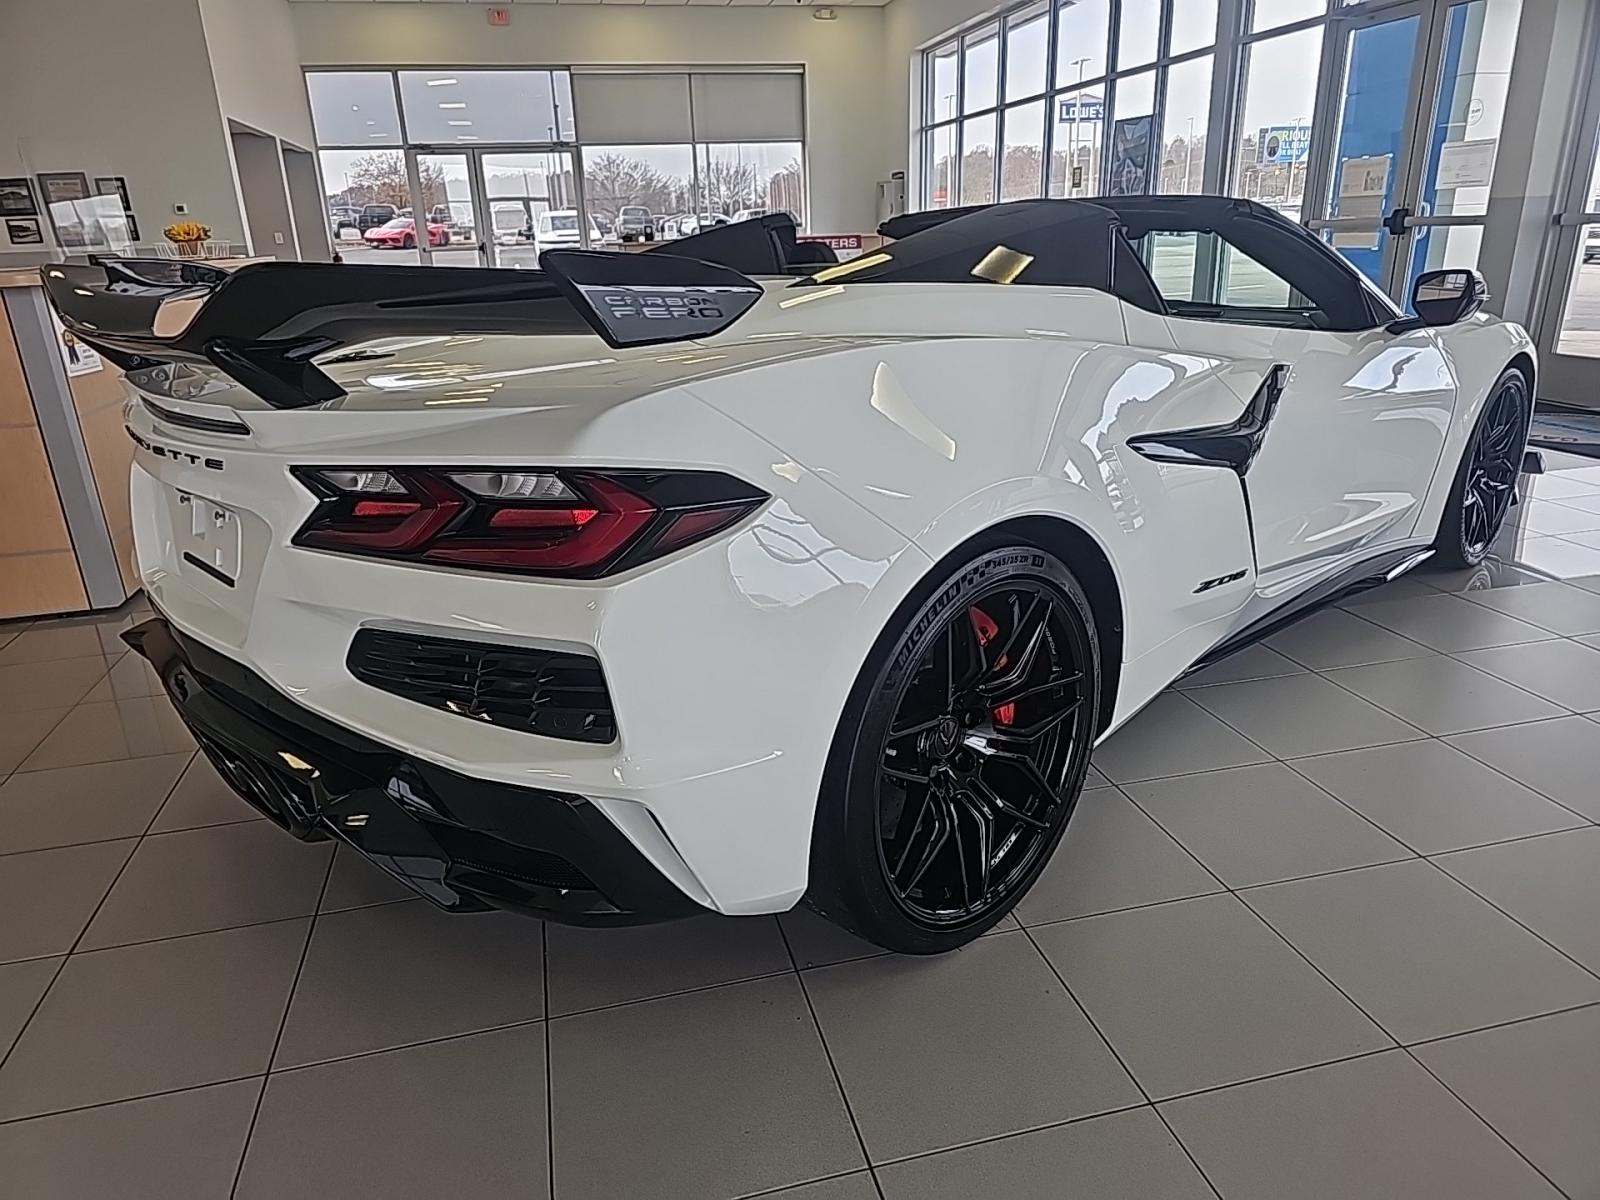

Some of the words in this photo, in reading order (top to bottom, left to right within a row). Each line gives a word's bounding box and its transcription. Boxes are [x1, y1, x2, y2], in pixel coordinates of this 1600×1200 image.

[1061, 105, 1104, 119] LOWE'S
[1192, 568, 1249, 593] Z06
[898, 584, 960, 667] MICHELIN
